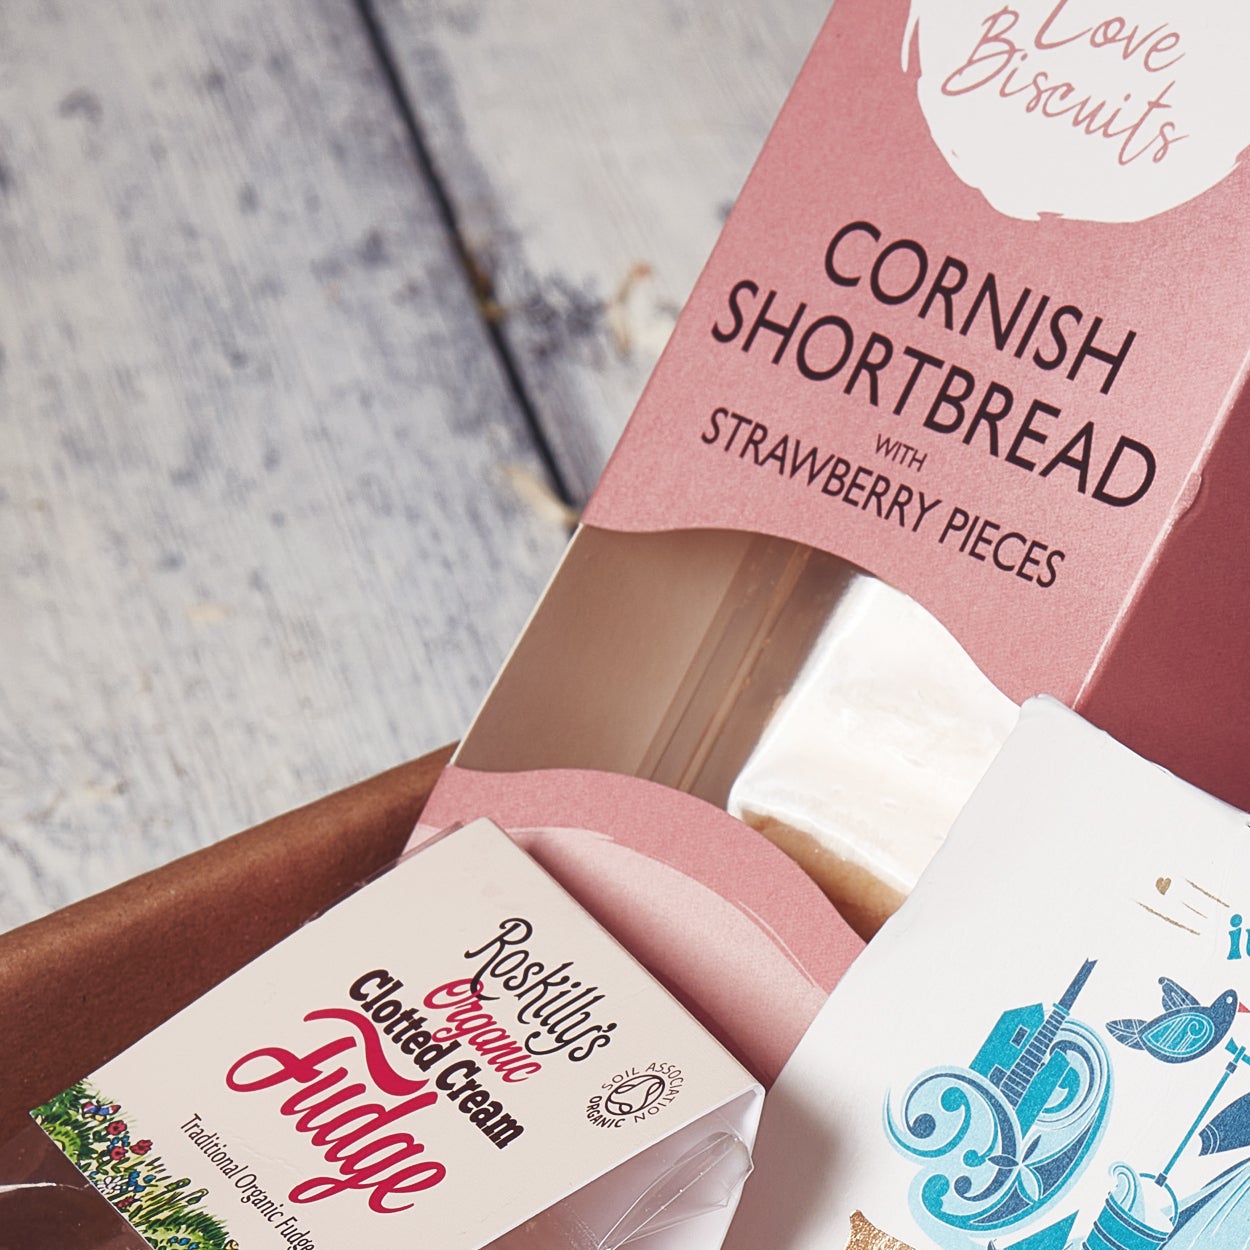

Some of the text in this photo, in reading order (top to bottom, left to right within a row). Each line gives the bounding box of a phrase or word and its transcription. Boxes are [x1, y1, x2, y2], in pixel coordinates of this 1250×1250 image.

[941, 6, 1189, 165] Biscuits
[1034, 0, 1185, 72] Love
[824, 220, 1136, 394] CORNISH
[711, 279, 1156, 507] SHORTBREAD
[876, 433, 927, 472] WITH
[701, 407, 1066, 589] STRAWBERRY PIECES
[348, 969, 525, 1150] Clotted Cream
[423, 978, 543, 1084] Organic
[464, 917, 618, 1063] Roskilly's
[226, 1008, 447, 1214] Fudge
[586, 1096, 626, 1128] ORGANIC
[602, 1062, 684, 1123] SOIL ASSOCIATION
[181, 1113, 248, 1179] Traditional
[235, 1174, 284, 1222] Organic
